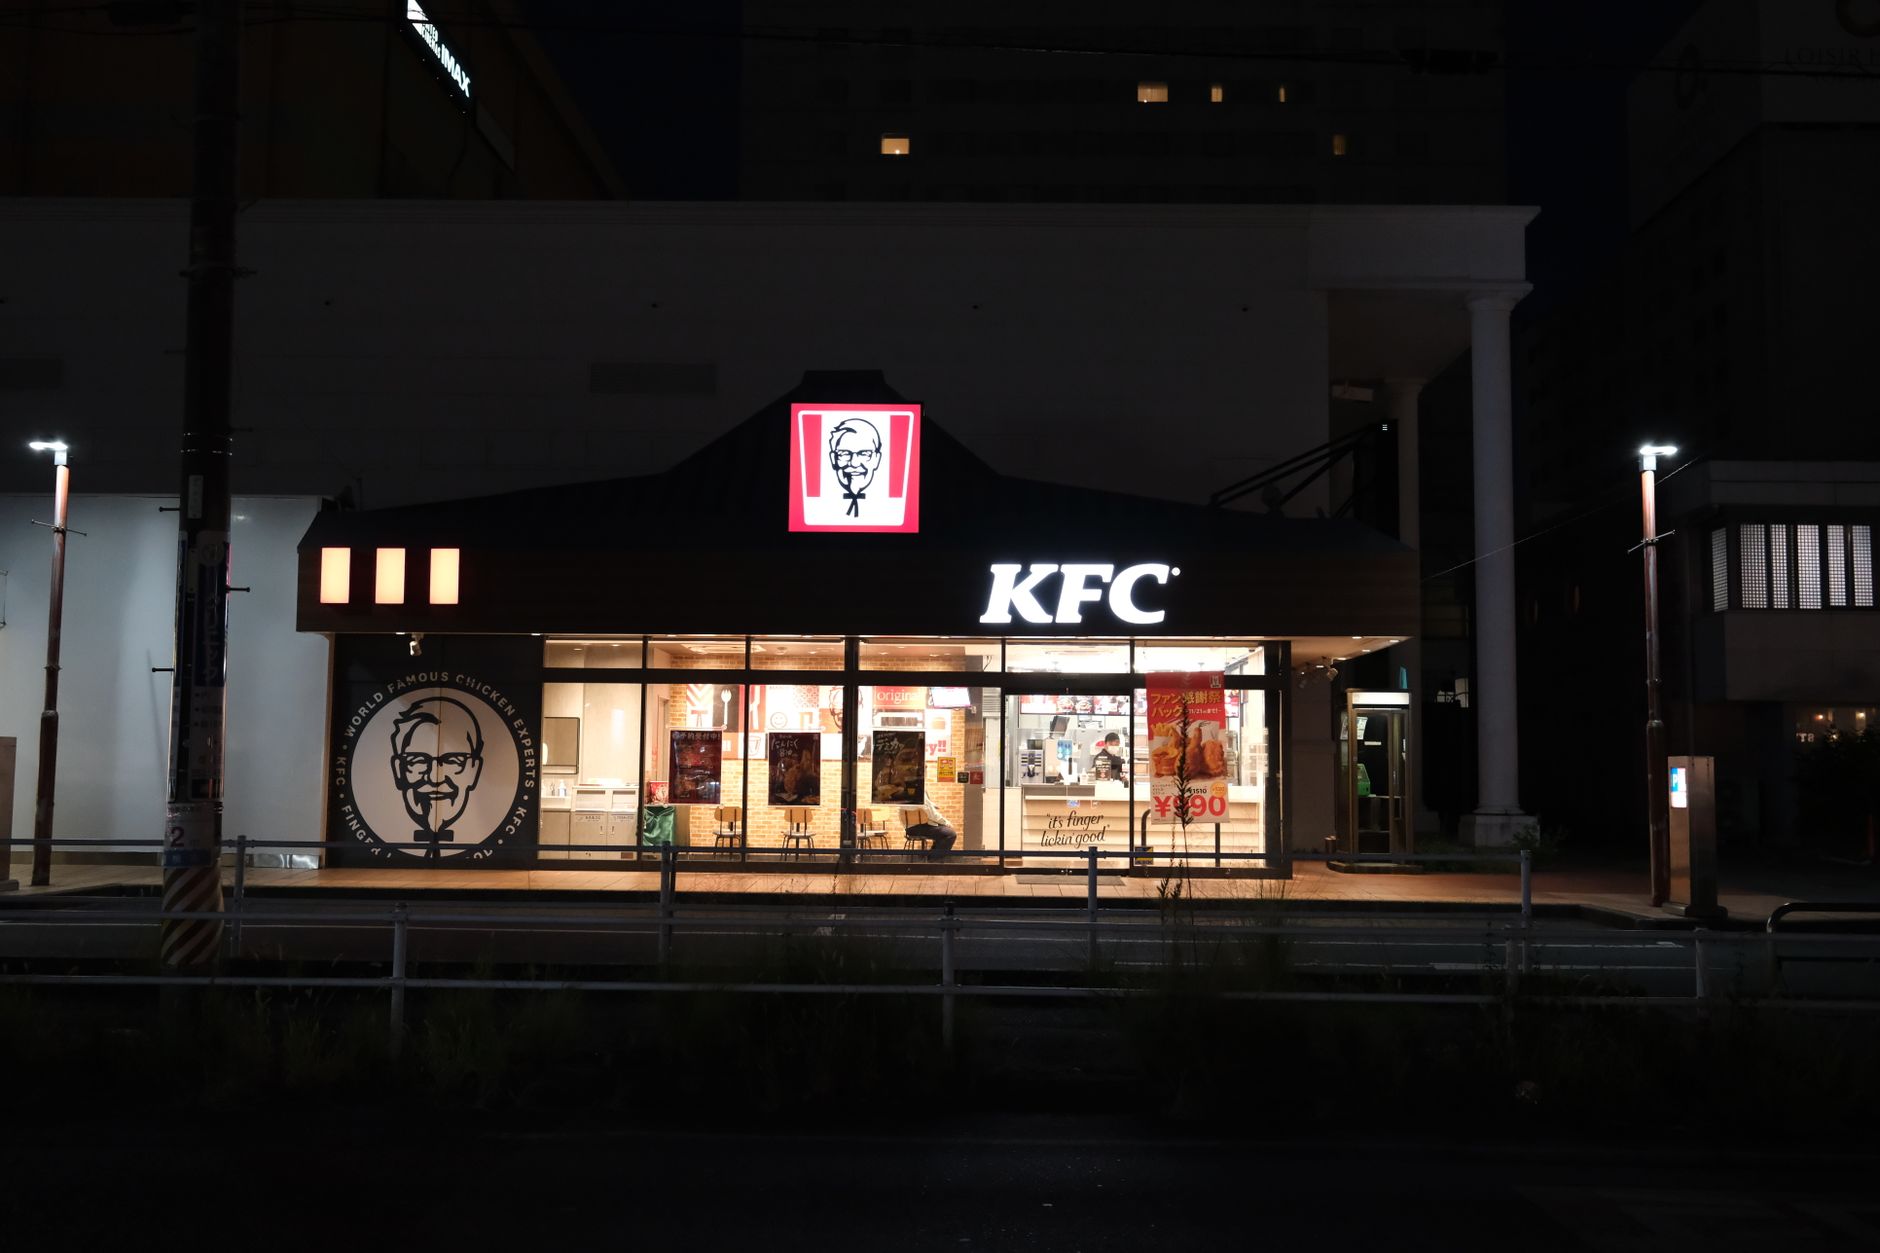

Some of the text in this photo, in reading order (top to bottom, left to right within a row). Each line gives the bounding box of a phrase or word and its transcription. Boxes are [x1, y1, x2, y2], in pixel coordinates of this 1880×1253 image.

[441, 44, 471, 98] IMAX
[979, 563, 1170, 624] KFC
[345, 671, 536, 789] WORLD FAMOUS CHICKEN EXPERTS
[335, 756, 347, 786] KFC
[505, 806, 528, 836] KFC
[1067, 810, 1104, 831] finger
